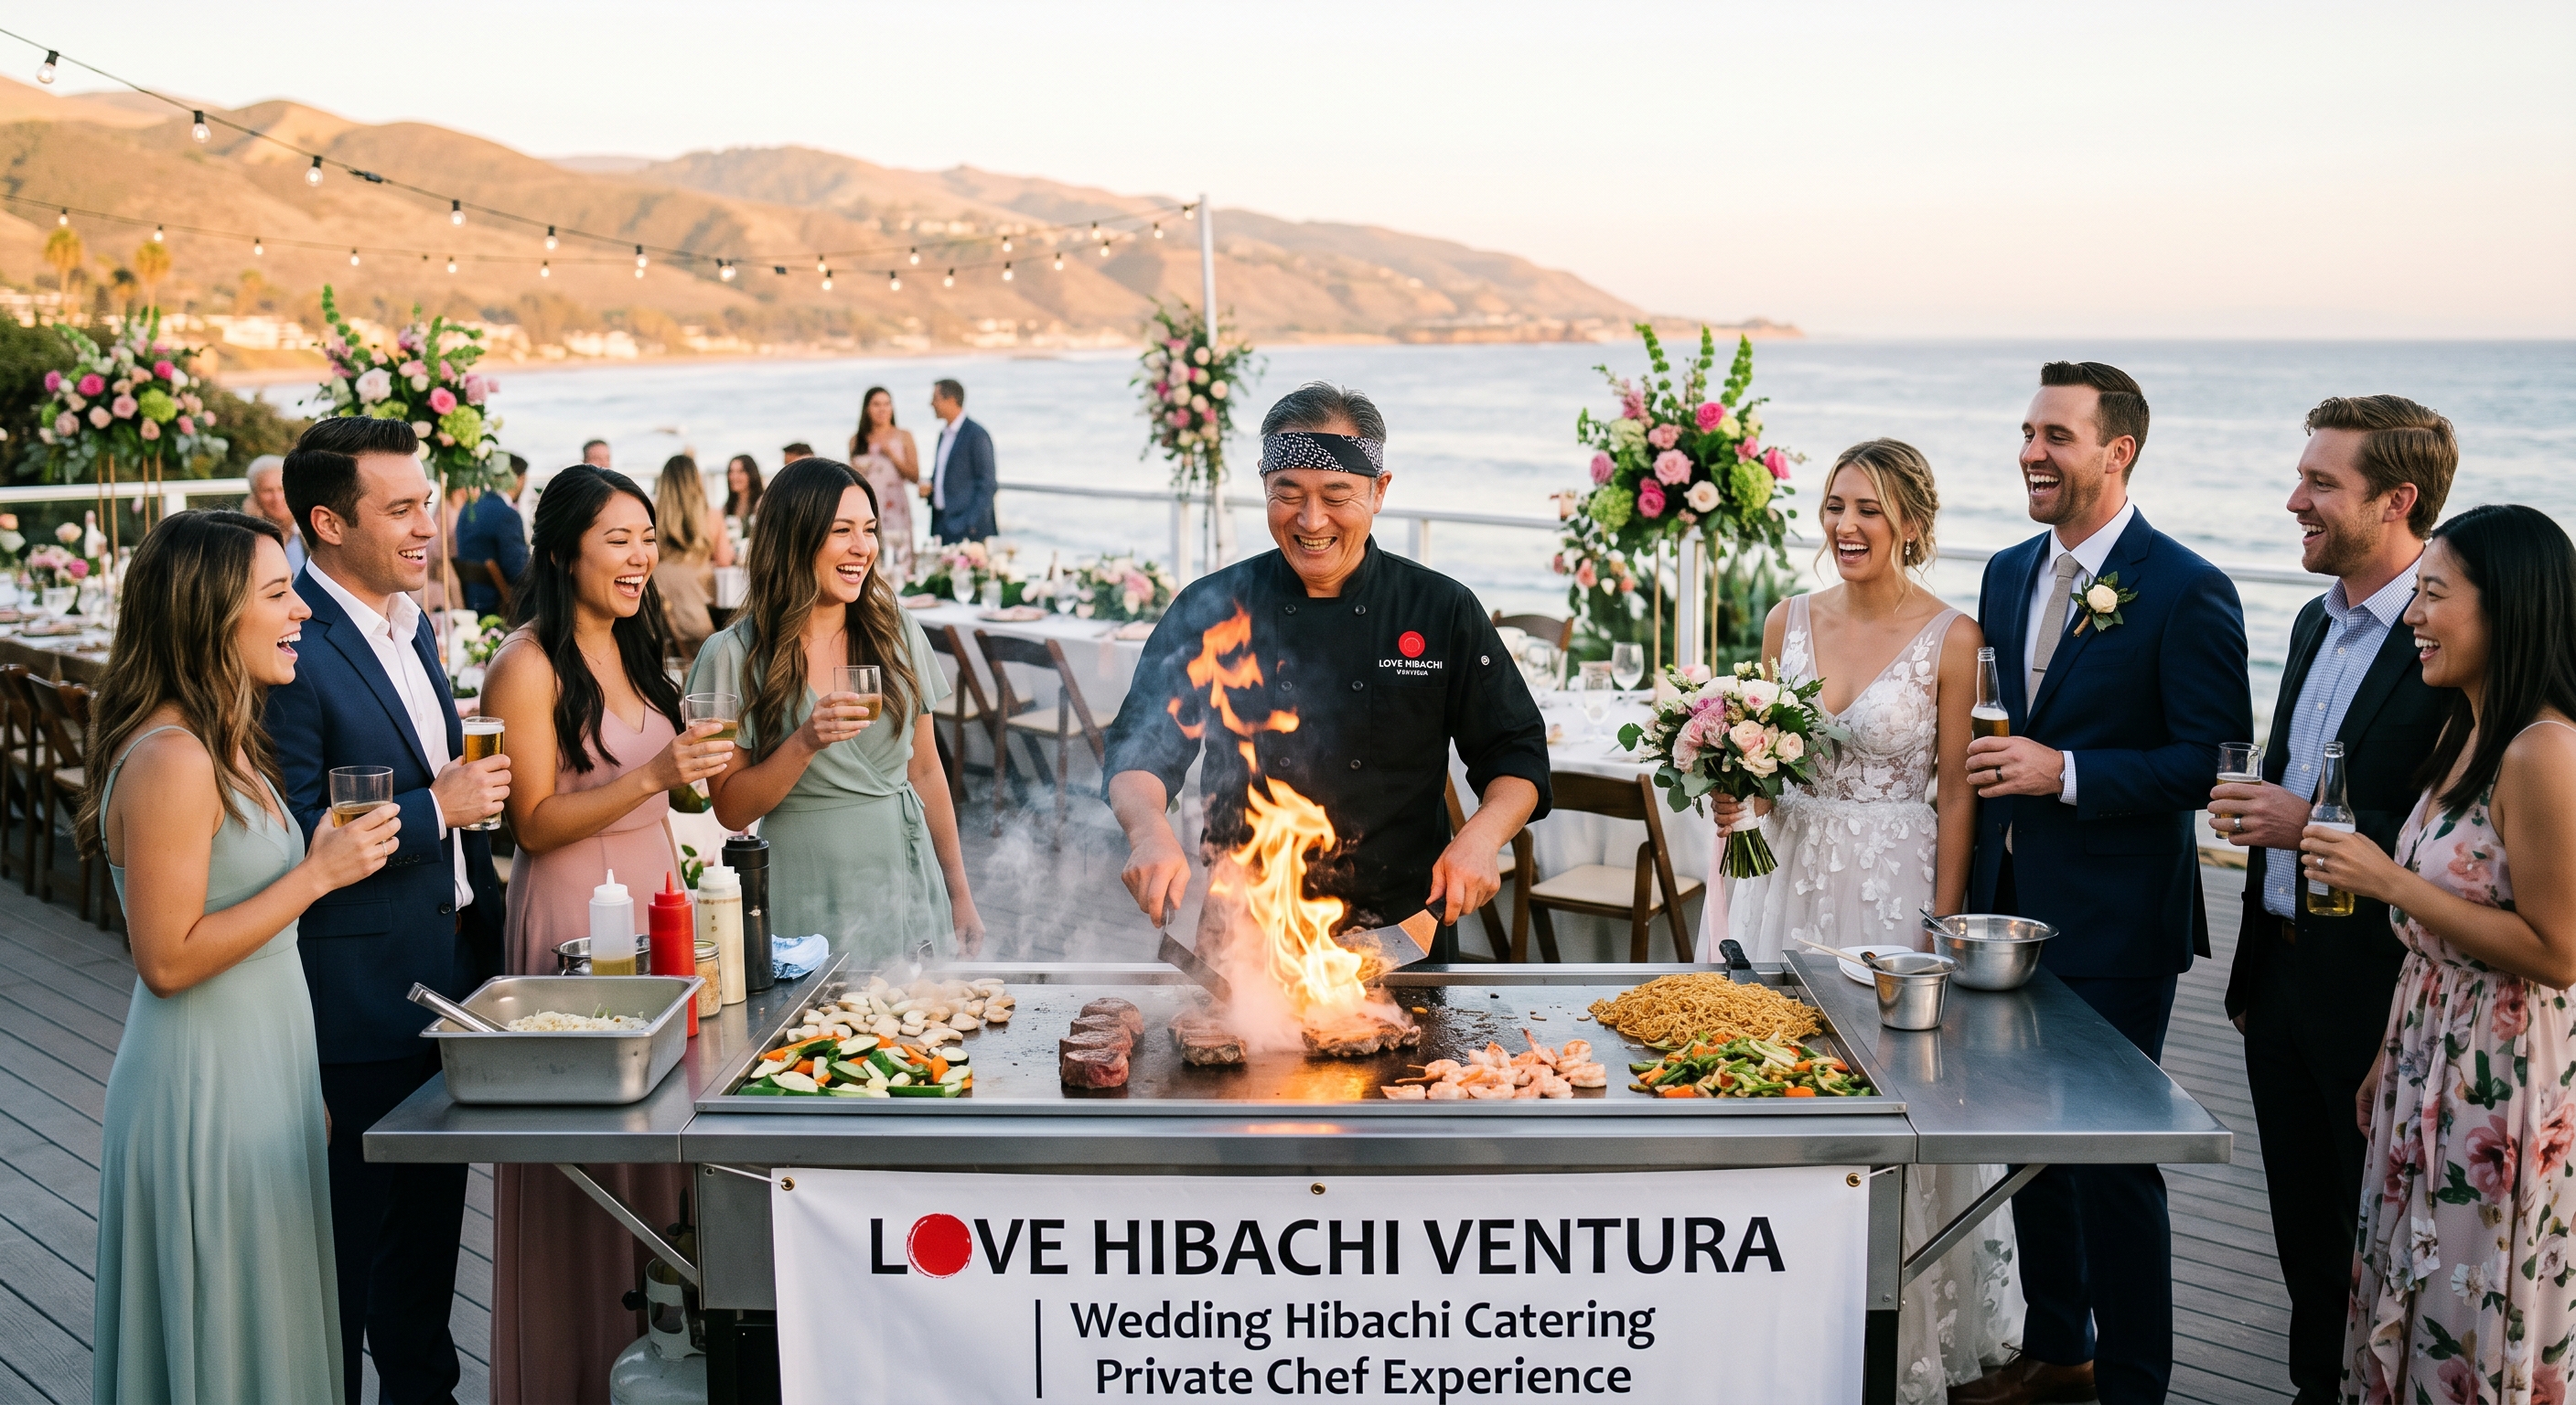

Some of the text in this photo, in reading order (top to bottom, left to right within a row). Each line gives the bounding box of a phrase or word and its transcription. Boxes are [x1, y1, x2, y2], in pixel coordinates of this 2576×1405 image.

[1379, 660, 1403, 668] LOVE
[871, 1214, 1786, 1278] LOVE HIBACHI VENTURA
[1070, 1300, 1656, 1350] Wedding Hibachi Catering
[1098, 1357, 1632, 1405] Private Chef Experience
